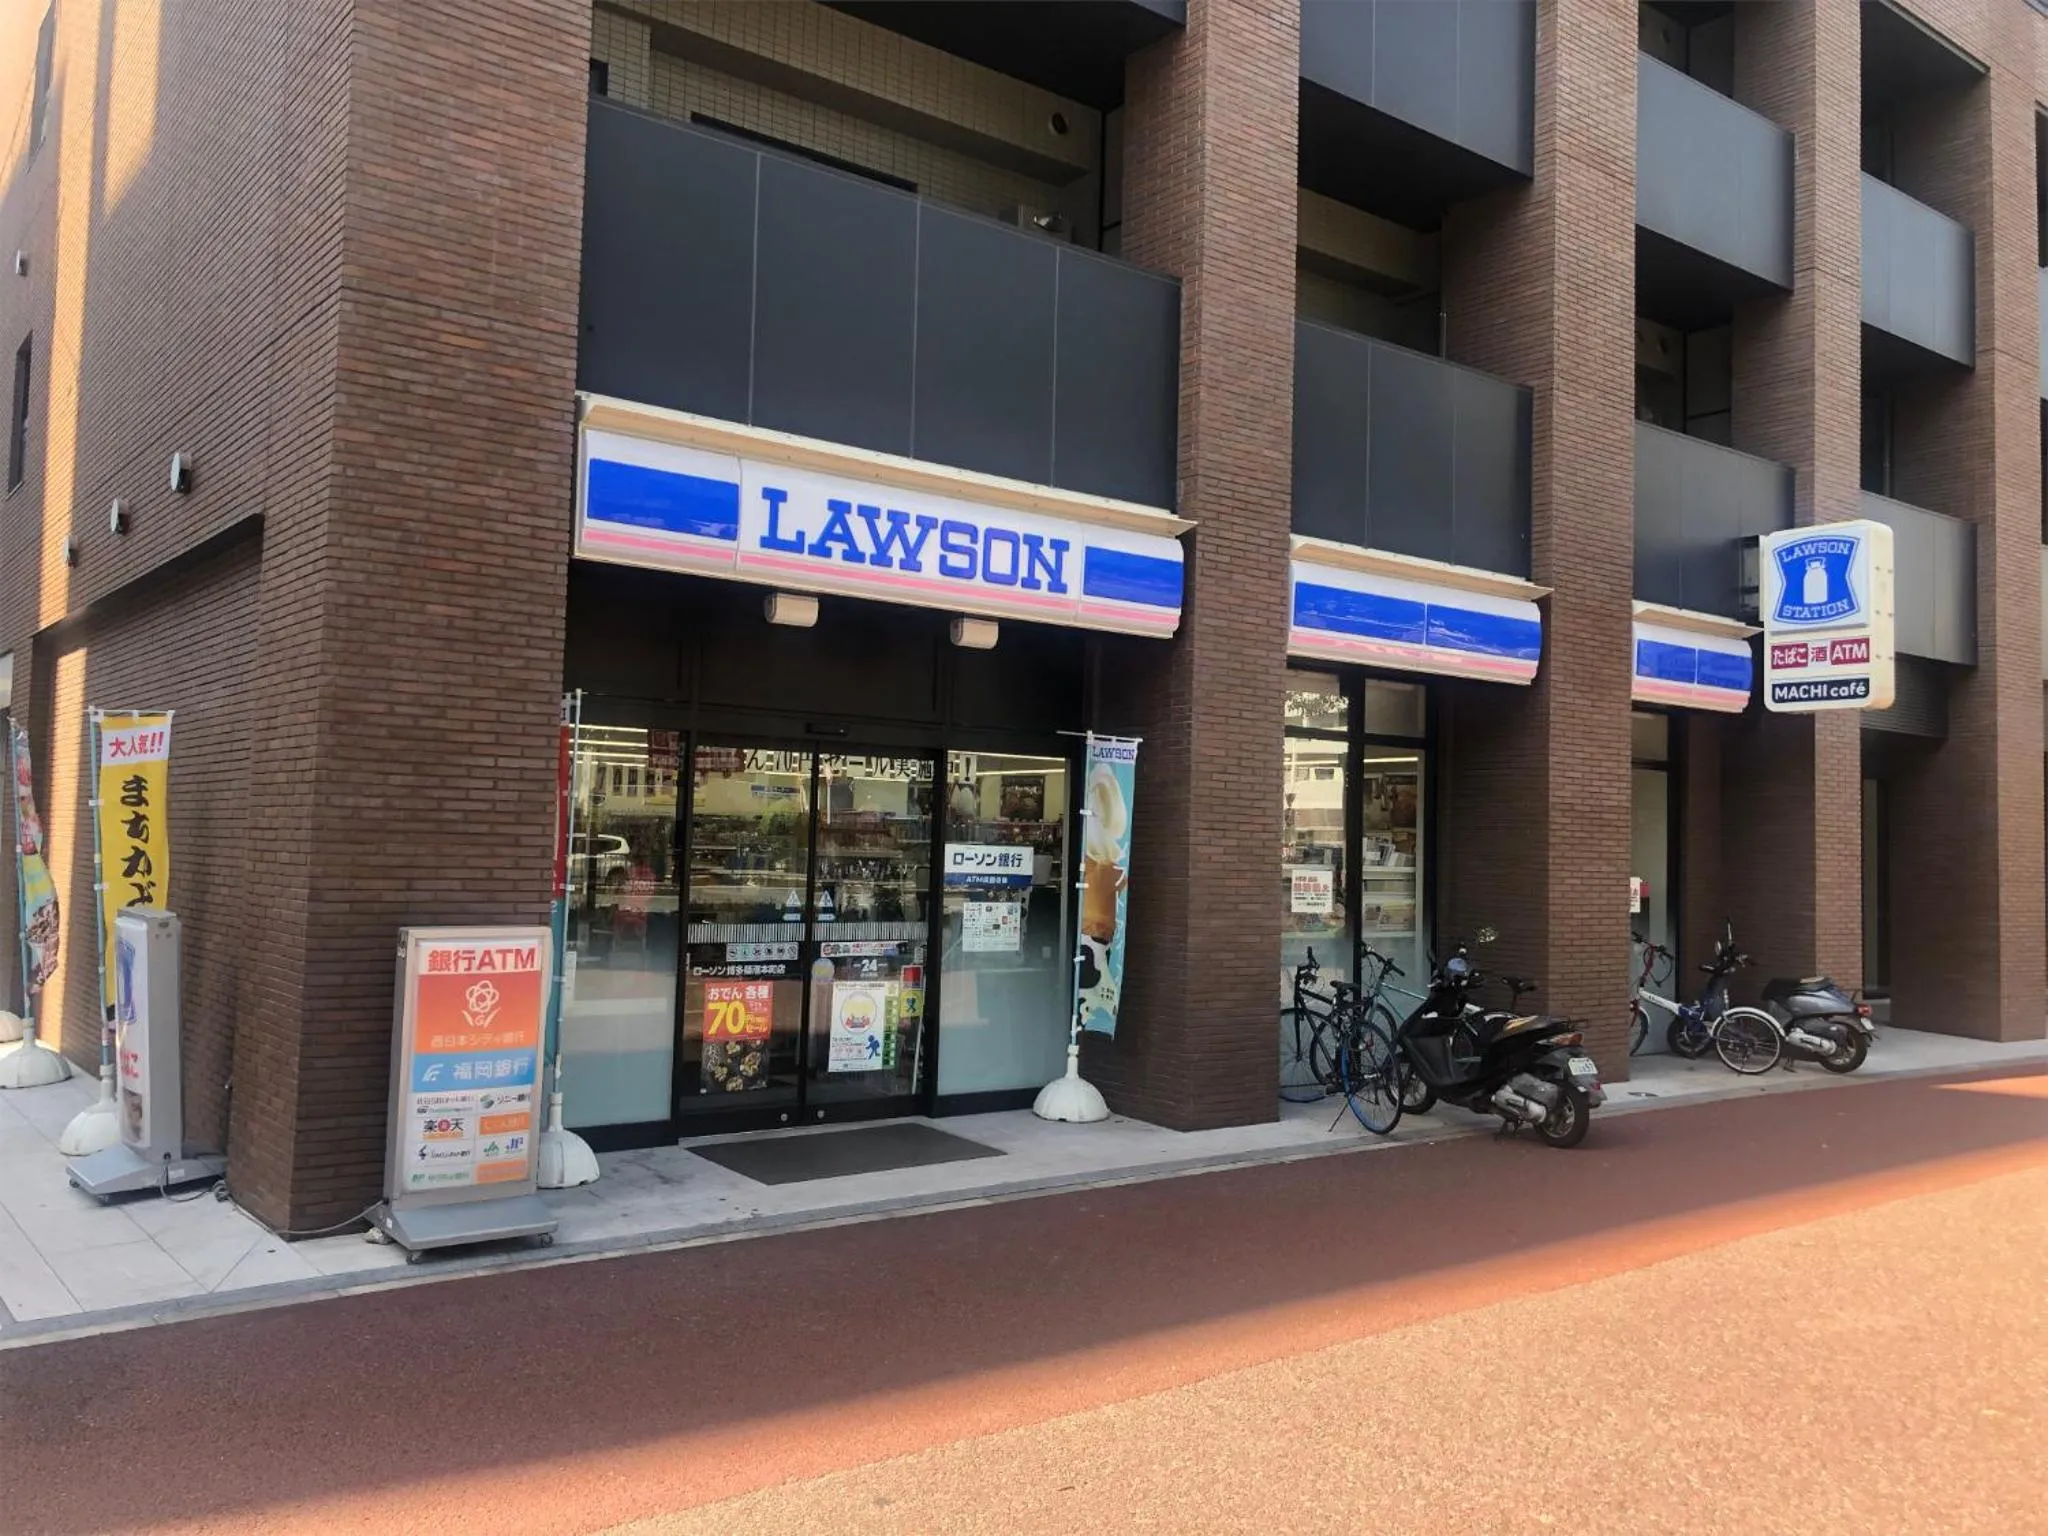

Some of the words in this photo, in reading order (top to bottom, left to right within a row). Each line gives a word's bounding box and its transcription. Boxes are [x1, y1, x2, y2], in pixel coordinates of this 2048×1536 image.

[759, 486, 1070, 594] LAWSON
[1782, 541, 1852, 563] LAWSON
[1782, 597, 1850, 619] STATION
[1772, 644, 1808, 667] たばこ
[1831, 642, 1868, 661] ATM
[1774, 683, 1828, 701] MACHI
[1829, 681, 1867, 697] café
[108, 731, 165, 758] 大人気!!
[1092, 745, 1136, 760] LAWSON
[952, 852, 1024, 868] ローソン銀行
[427, 946, 537, 973] 銀行ATM
[861, 958, 878, 972] 24
[708, 987, 742, 1001] おでん
[745, 985, 770, 999] 各種
[707, 1000, 745, 1036] 70
[453, 1056, 531, 1081] 福岡銀行
